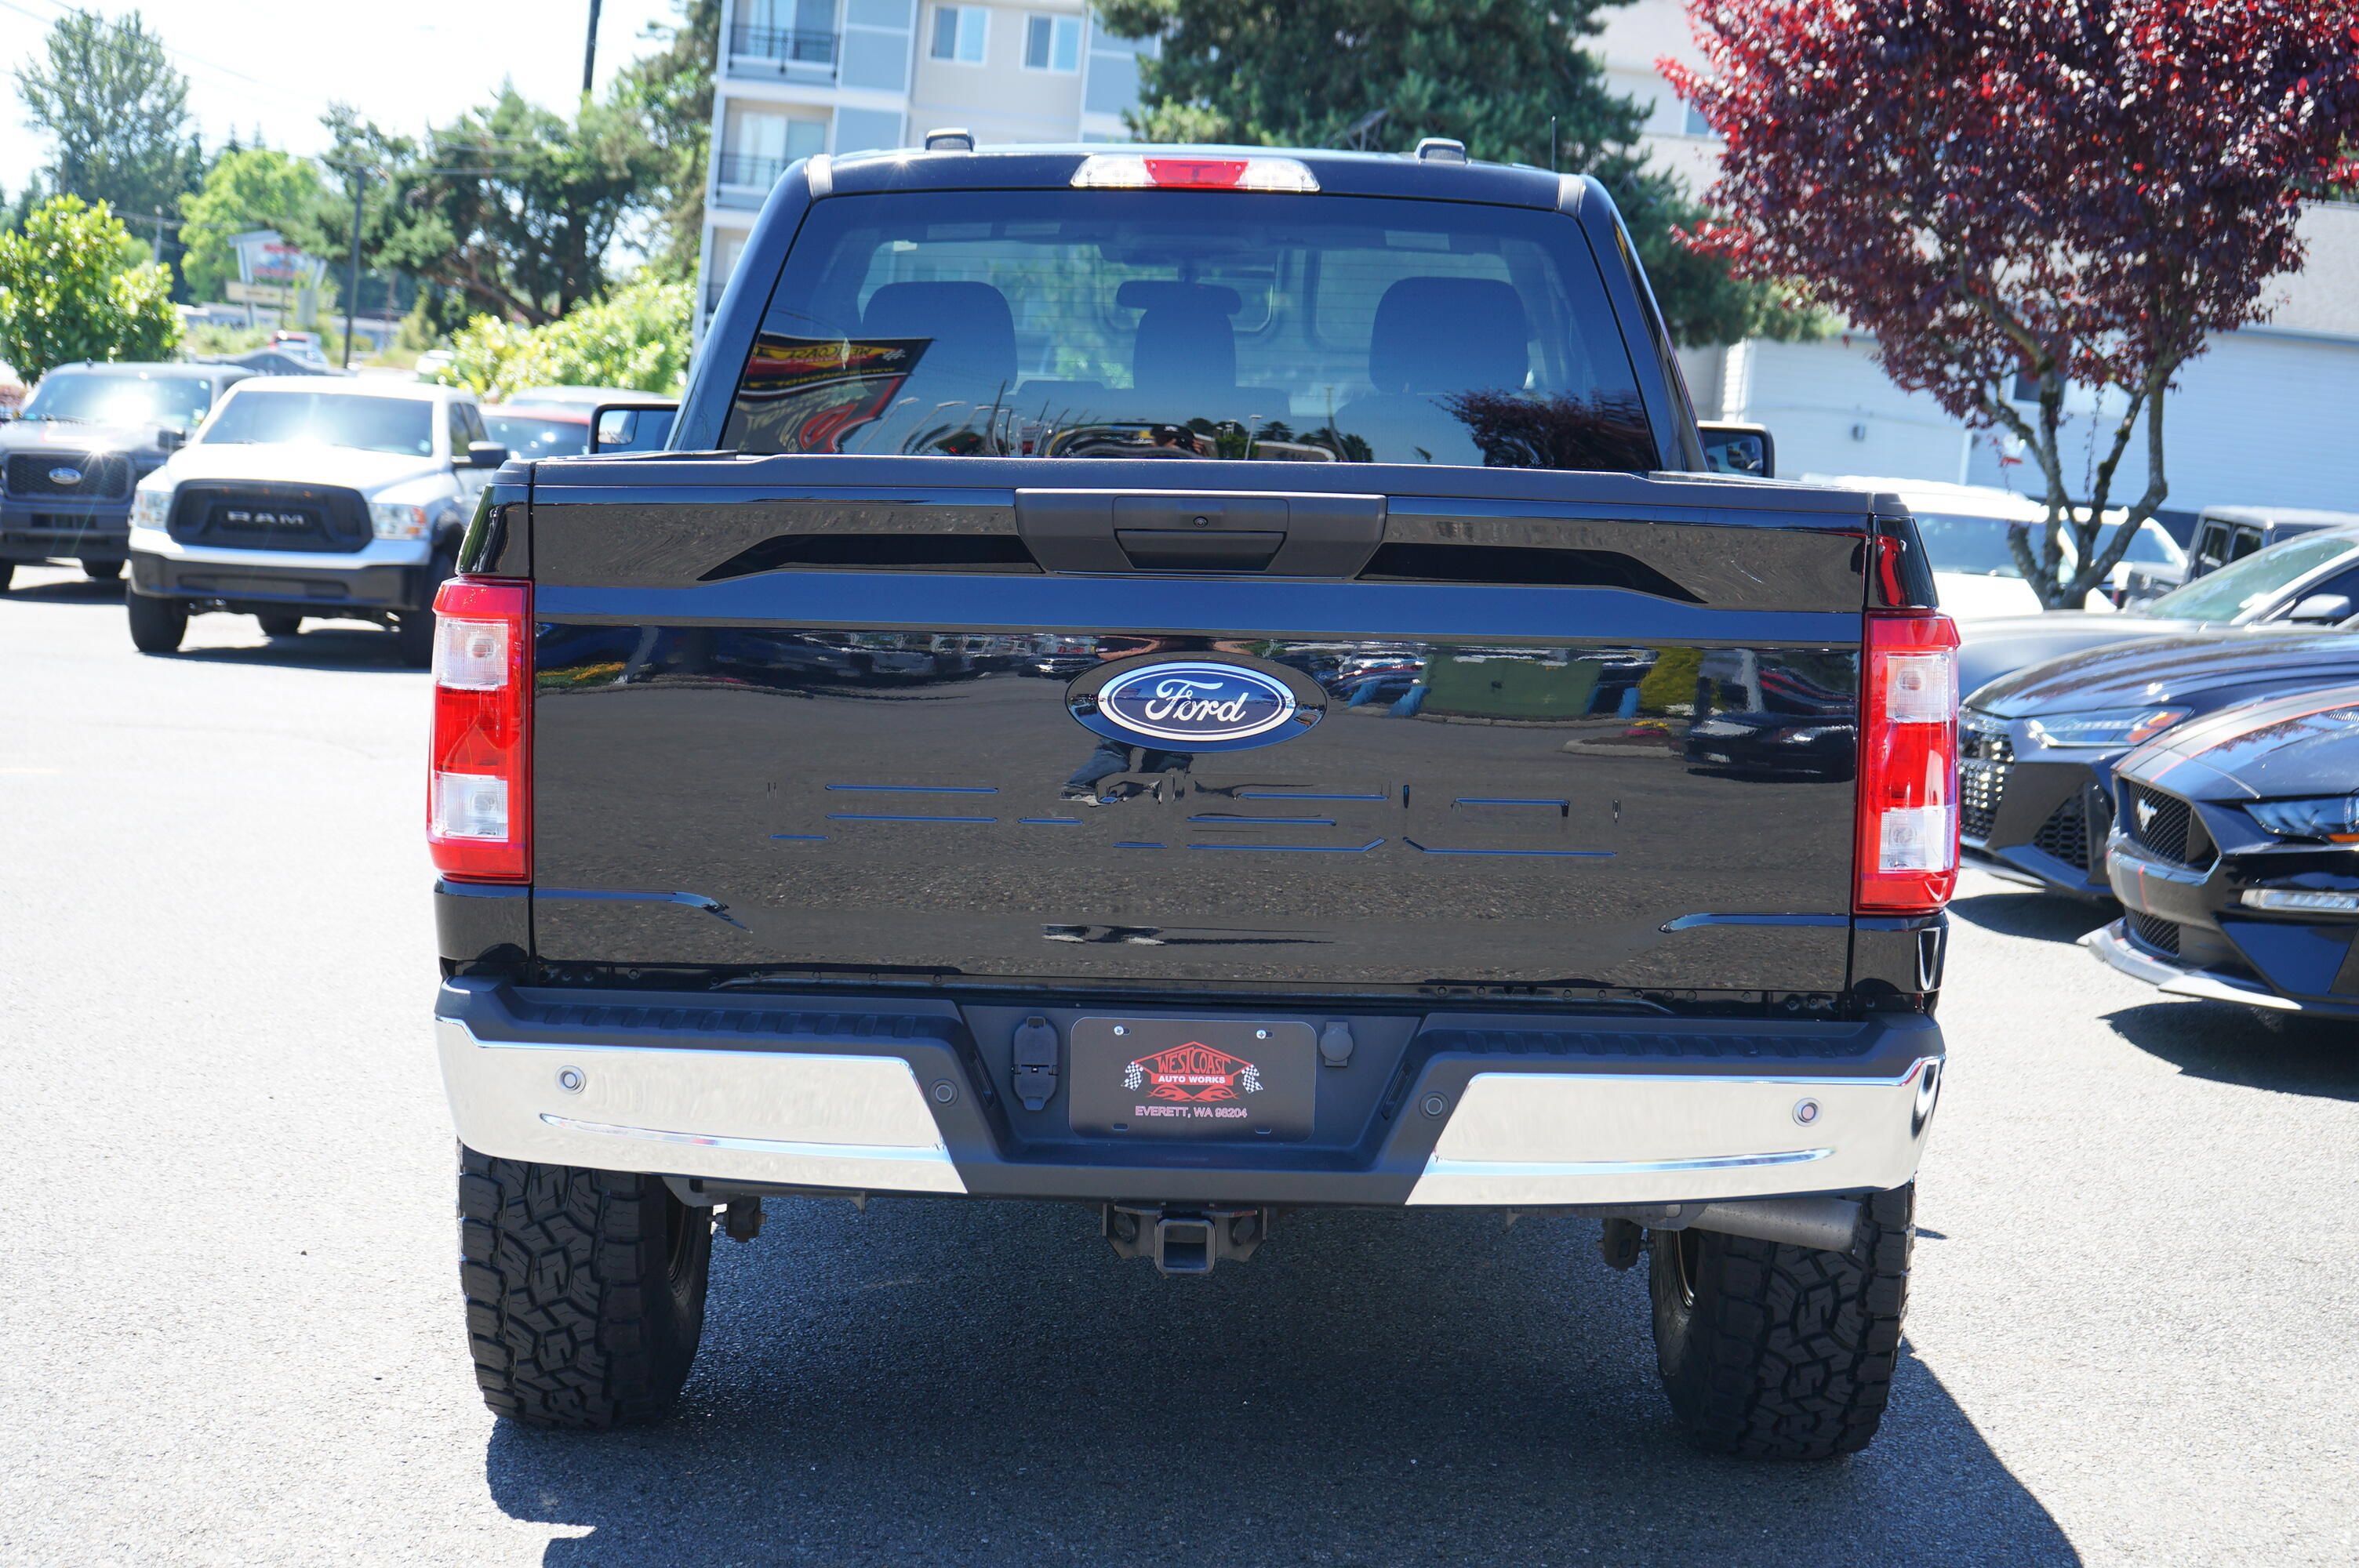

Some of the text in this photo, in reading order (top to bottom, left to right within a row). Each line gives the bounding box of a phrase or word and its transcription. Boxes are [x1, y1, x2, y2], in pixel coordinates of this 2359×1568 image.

[227, 510, 304, 524] RAM
[1145, 679, 1249, 722] Ford
[1189, 1076, 1225, 1084] WORKS
[1135, 1105, 1191, 1119] EVERETT,
[1194, 1107, 1213, 1118] WA
